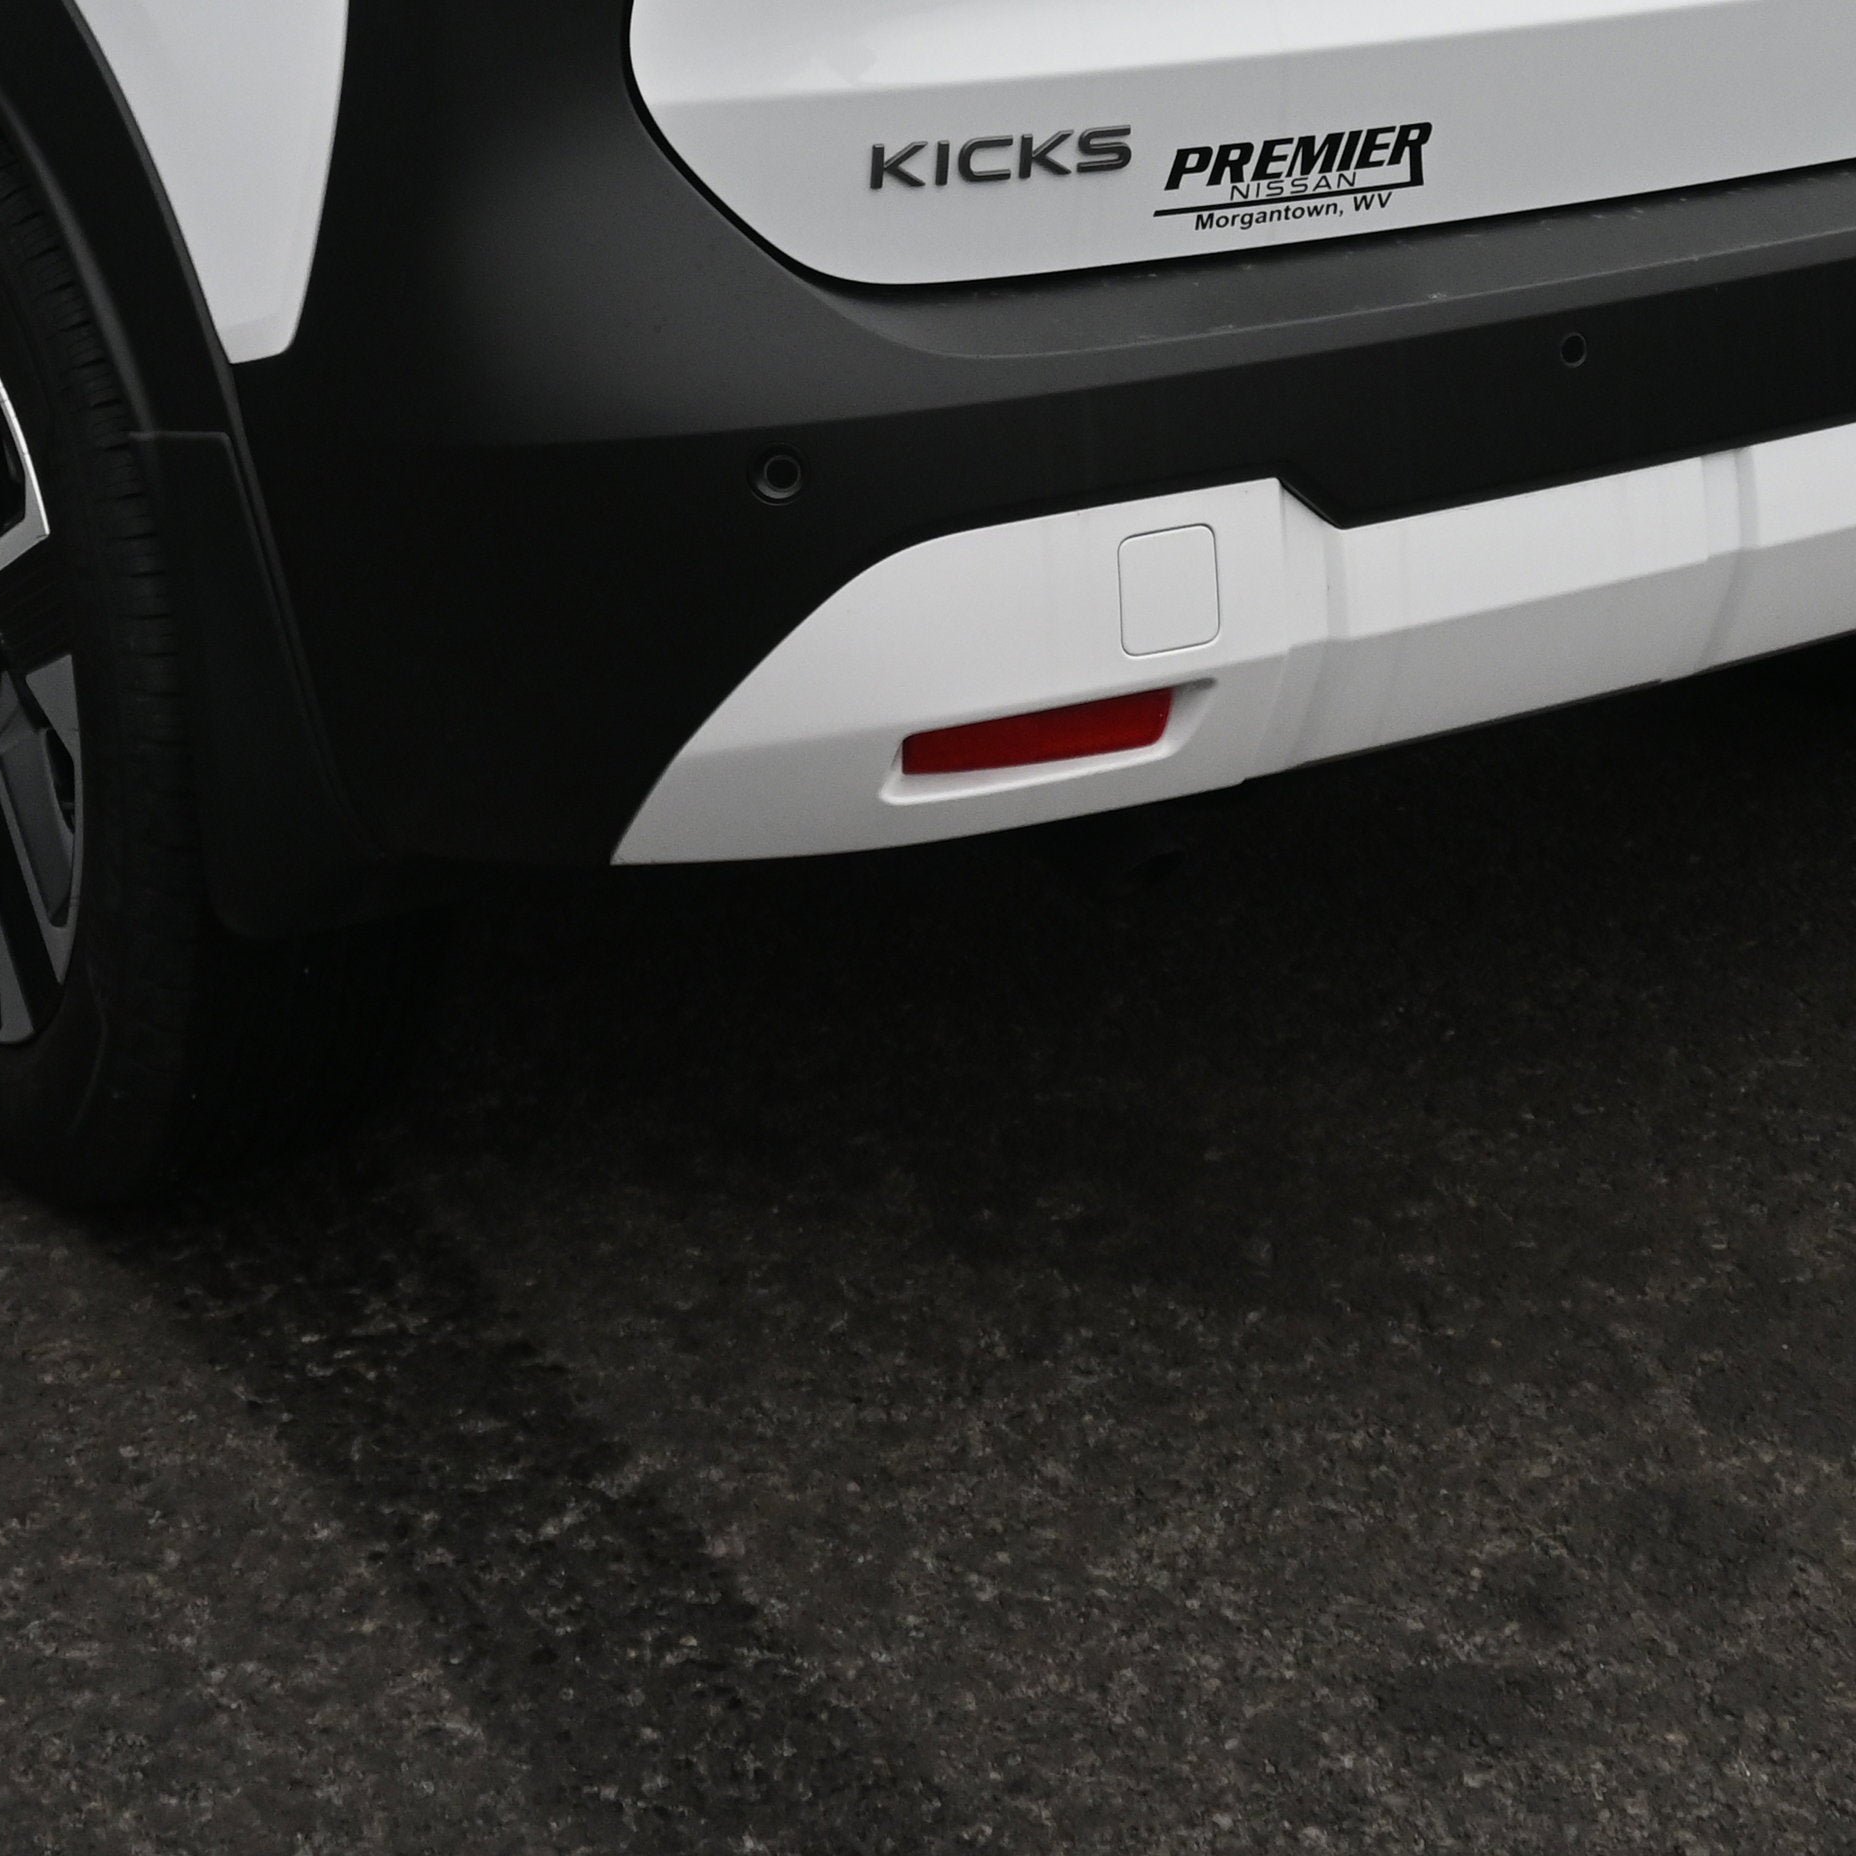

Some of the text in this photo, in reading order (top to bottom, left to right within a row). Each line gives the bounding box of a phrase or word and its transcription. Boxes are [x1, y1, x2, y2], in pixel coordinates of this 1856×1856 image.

[869, 124, 1133, 190] KICKS
[1164, 121, 1432, 192] PREMIER
[1195, 192, 1394, 231] Morgantown, WV
[1230, 171, 1358, 201] NISSAN
